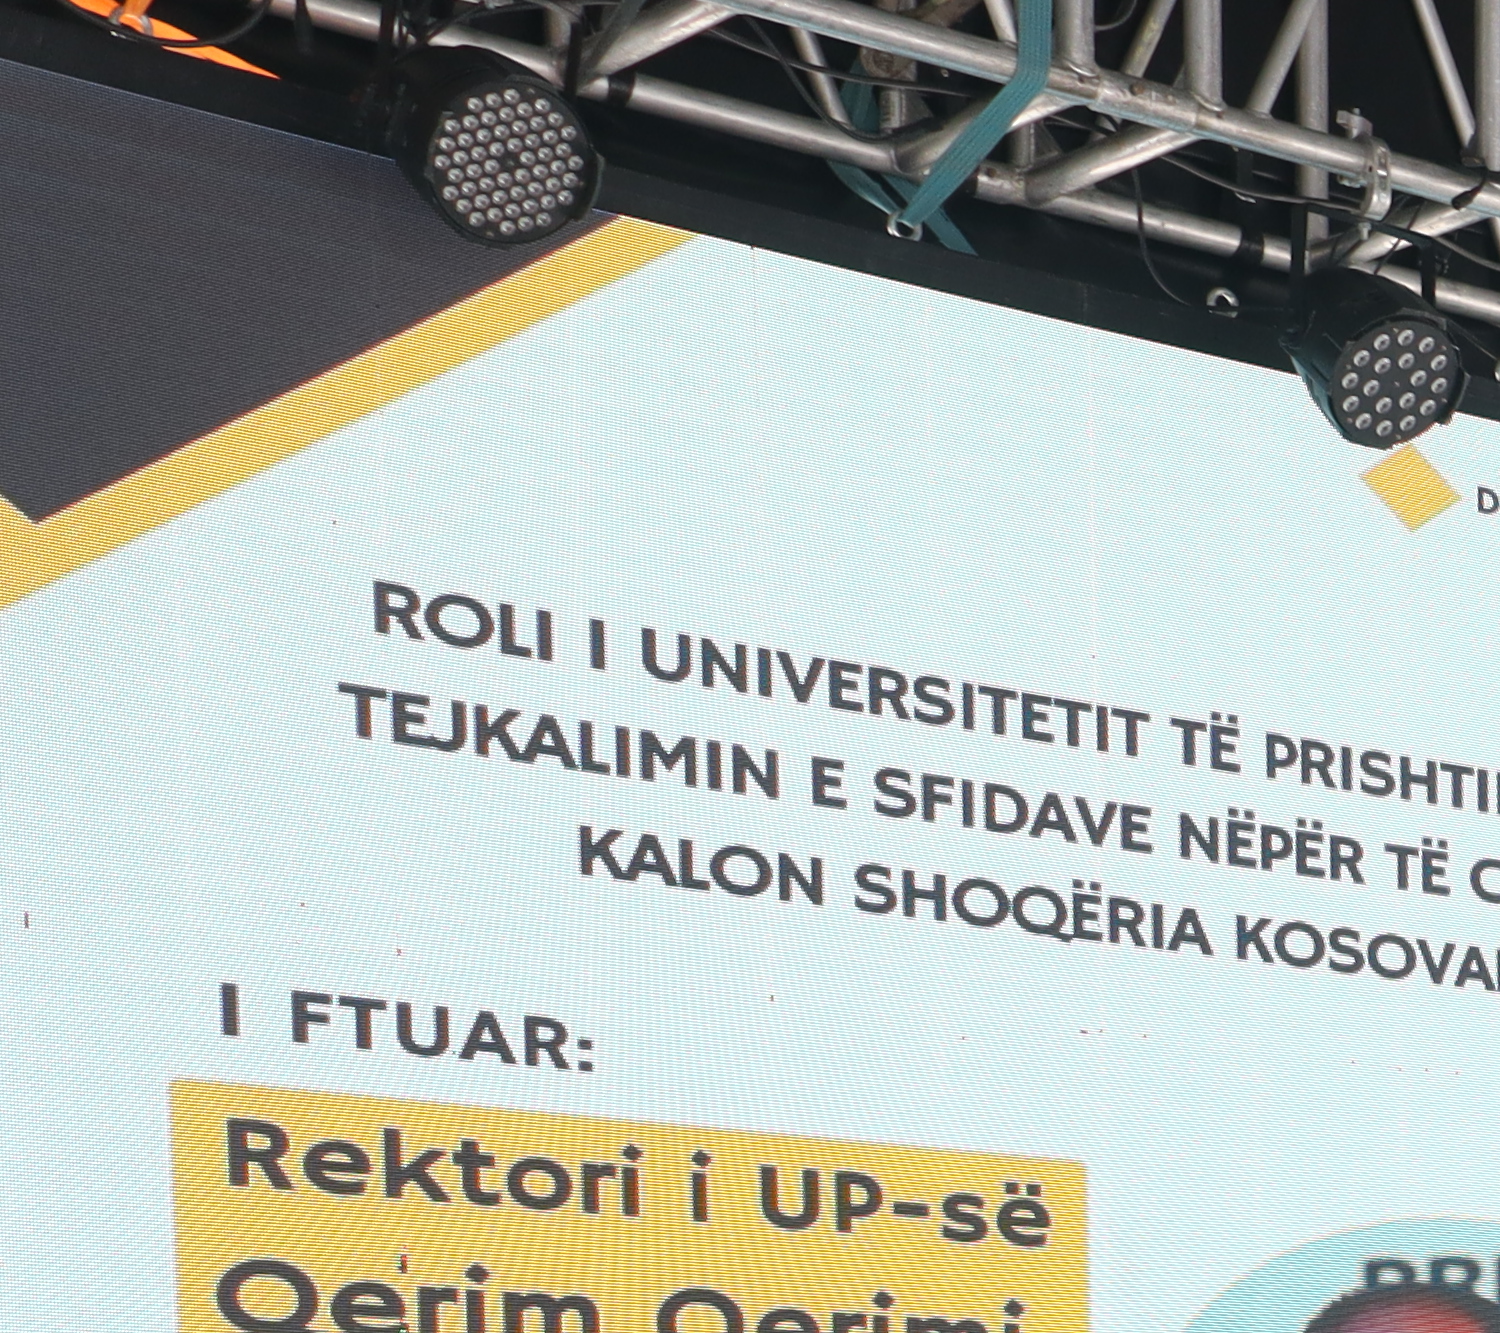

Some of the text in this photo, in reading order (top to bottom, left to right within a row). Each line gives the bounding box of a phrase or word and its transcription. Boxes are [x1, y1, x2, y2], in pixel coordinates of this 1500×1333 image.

[373, 580, 554, 661] ROLI
[589, 618, 606, 671] I
[641, 626, 1150, 757] UNIVERSITETIT
[1170, 712, 1242, 773] TË
[338, 681, 779, 800] TEJKALIMIN
[811, 756, 848, 810] E
[874, 767, 1154, 854] SFIDAVE
[1179, 808, 1365, 885] NËPËR
[1385, 837, 1451, 896] TË
[578, 824, 824, 906] KALON
[853, 862, 1213, 956] SHOQËRIA
[220, 983, 596, 1072] I FTUAR:
[224, 1117, 1052, 1247] Rektori i UP-së
